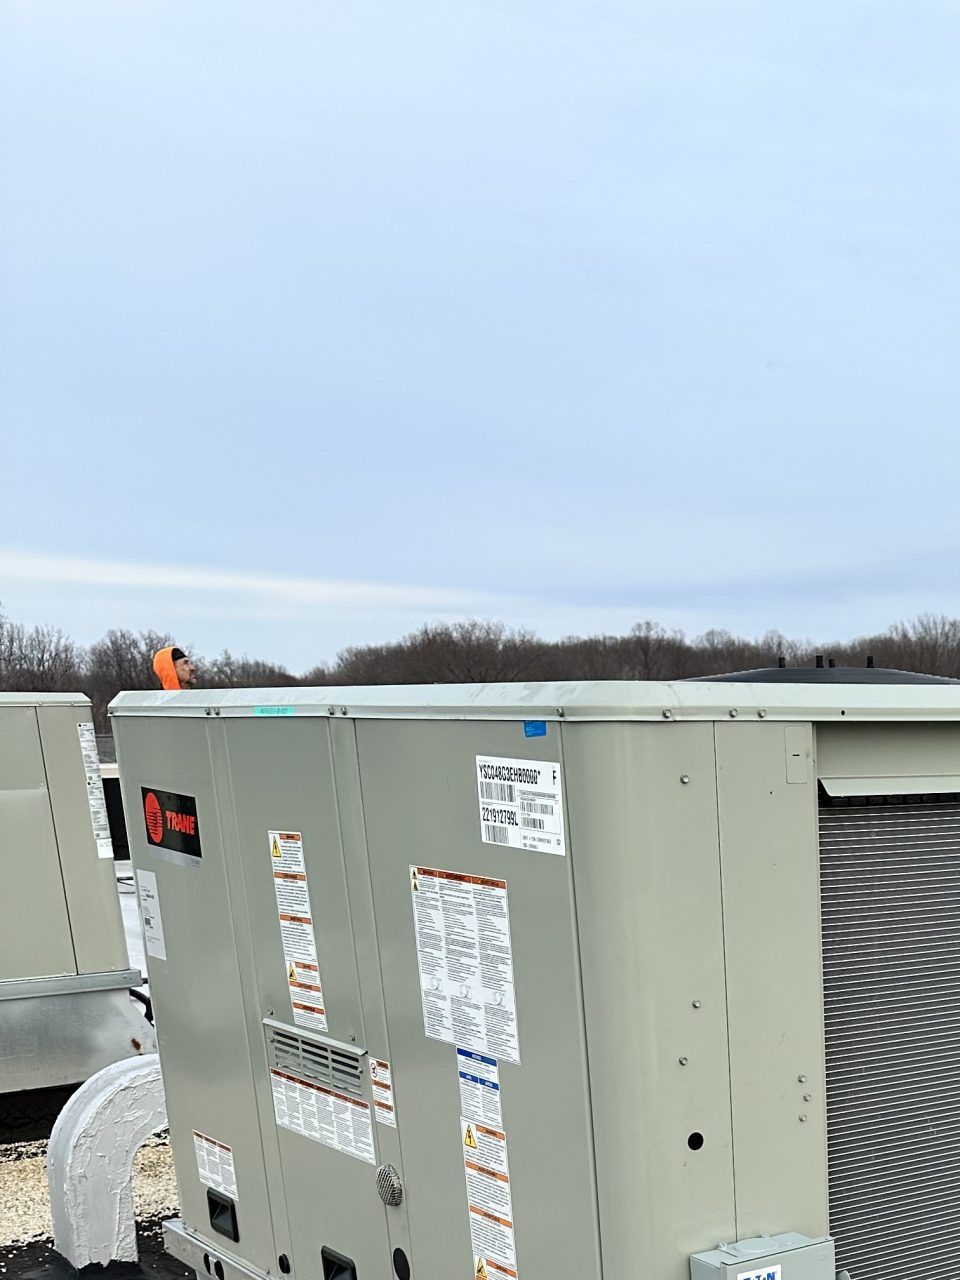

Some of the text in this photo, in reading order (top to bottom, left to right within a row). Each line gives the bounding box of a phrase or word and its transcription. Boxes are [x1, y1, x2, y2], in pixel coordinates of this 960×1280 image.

[552, 769, 557, 786] F
[165, 810, 195, 835] TRANE
[482, 806, 519, 826] 221912799L
